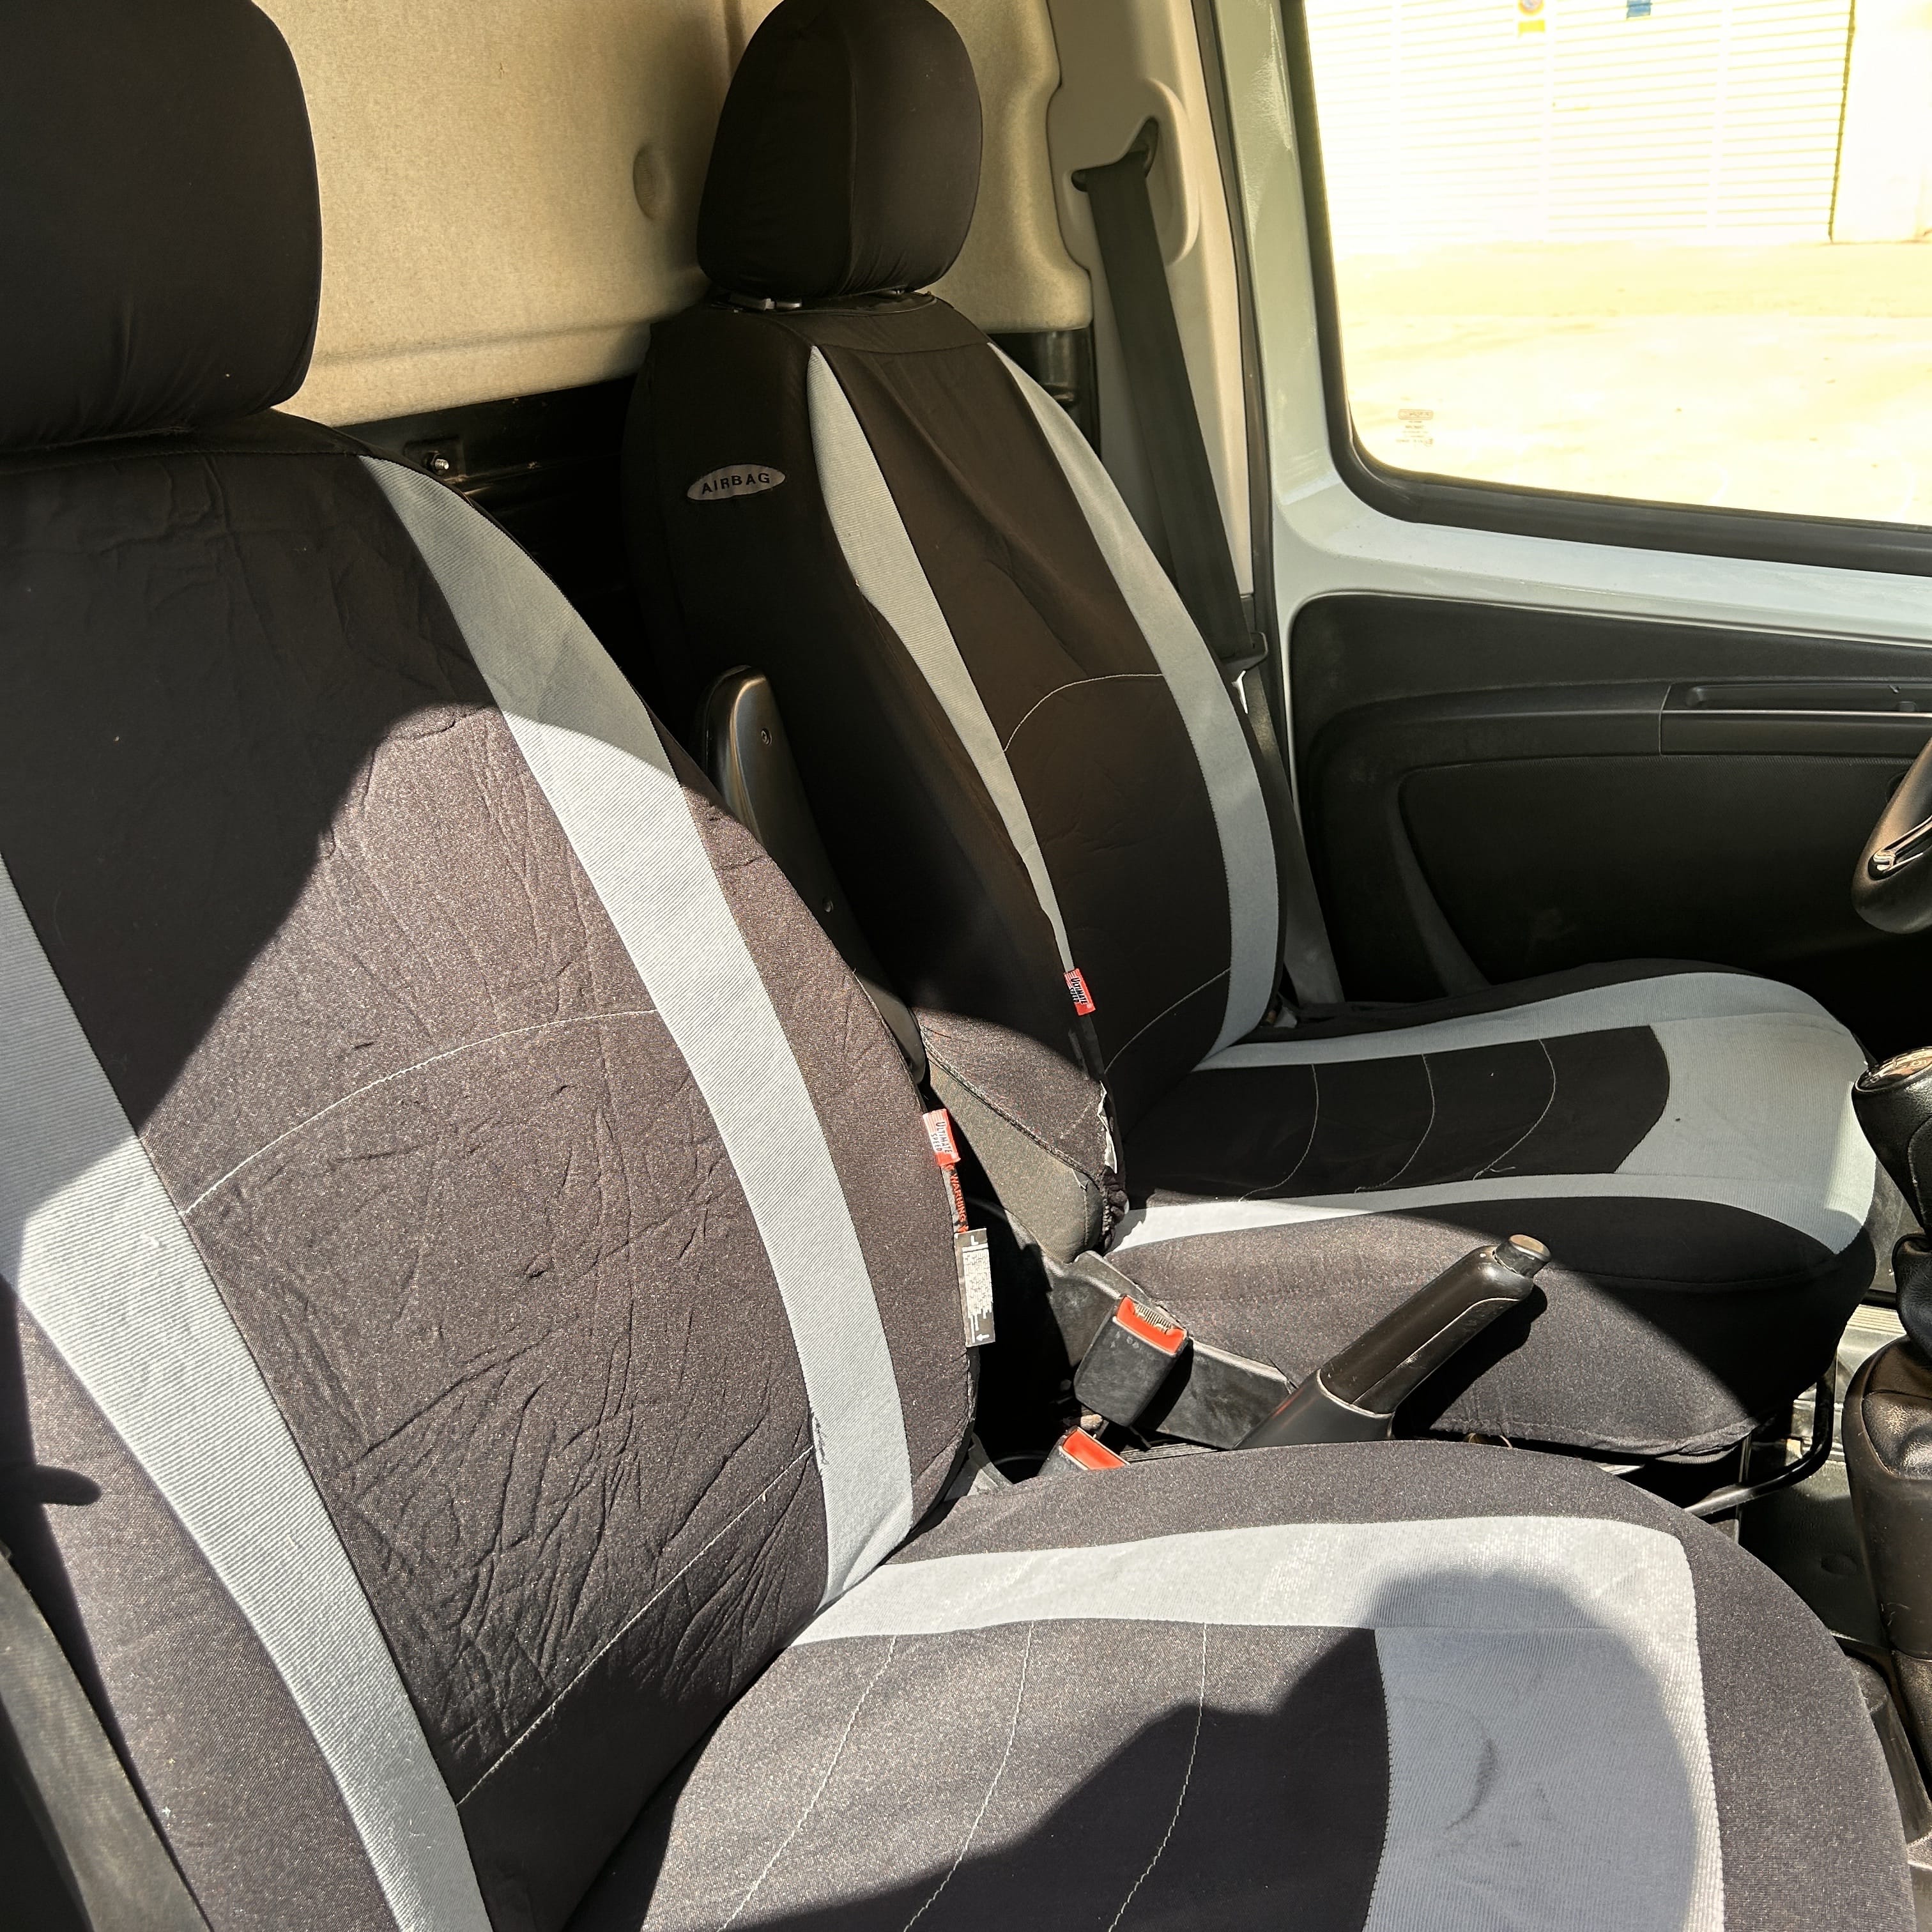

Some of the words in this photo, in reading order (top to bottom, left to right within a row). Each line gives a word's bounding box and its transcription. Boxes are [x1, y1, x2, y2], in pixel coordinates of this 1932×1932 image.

[702, 473, 770, 494] AIRBAG
[1070, 977, 1087, 1004] ULTIMATE
[931, 1133, 942, 1151] SPEED
[936, 1122, 953, 1153] ULTIMATE
[950, 1173, 967, 1222] WARNING
